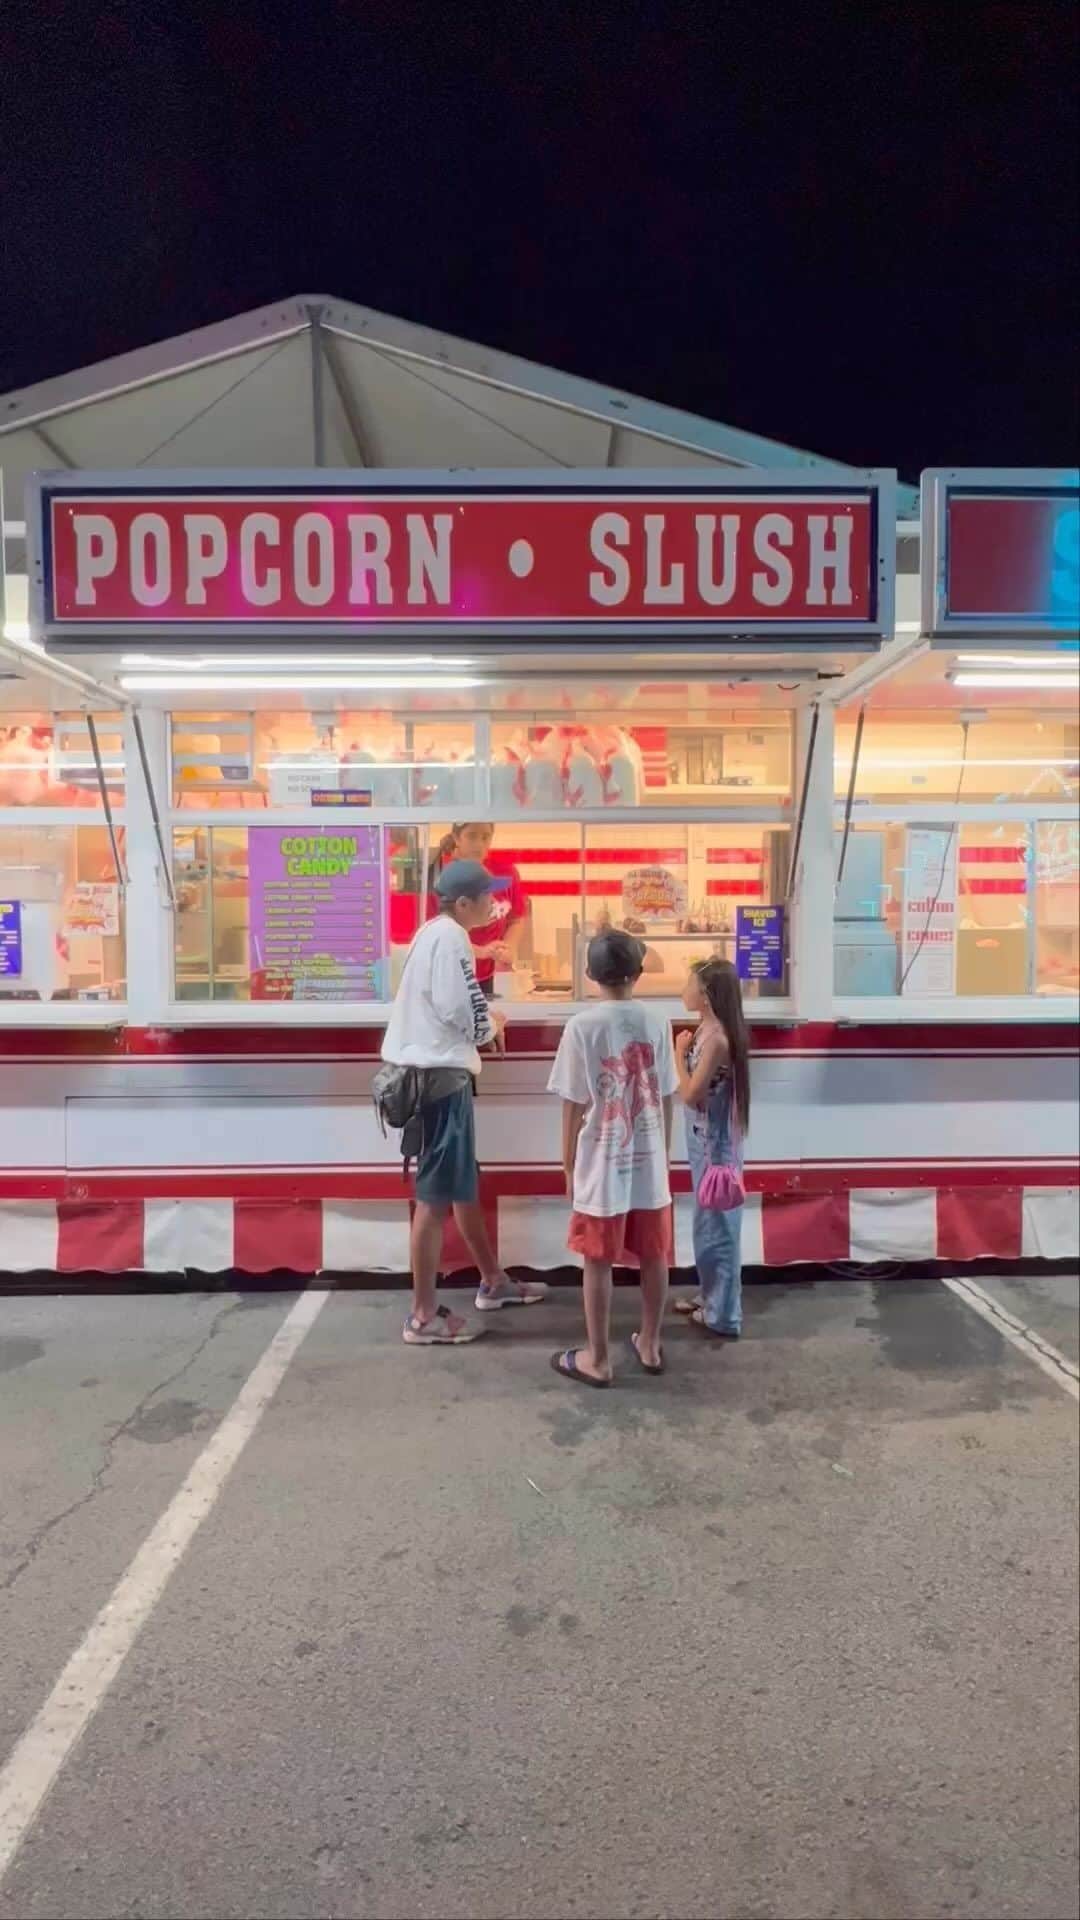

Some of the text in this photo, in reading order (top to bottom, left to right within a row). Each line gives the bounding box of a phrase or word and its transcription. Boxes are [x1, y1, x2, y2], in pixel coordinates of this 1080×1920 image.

[73, 512, 854, 607] POPCORN SLUSH
[280, 837, 357, 857] COTTON
[286, 858, 350, 876] CANDY
